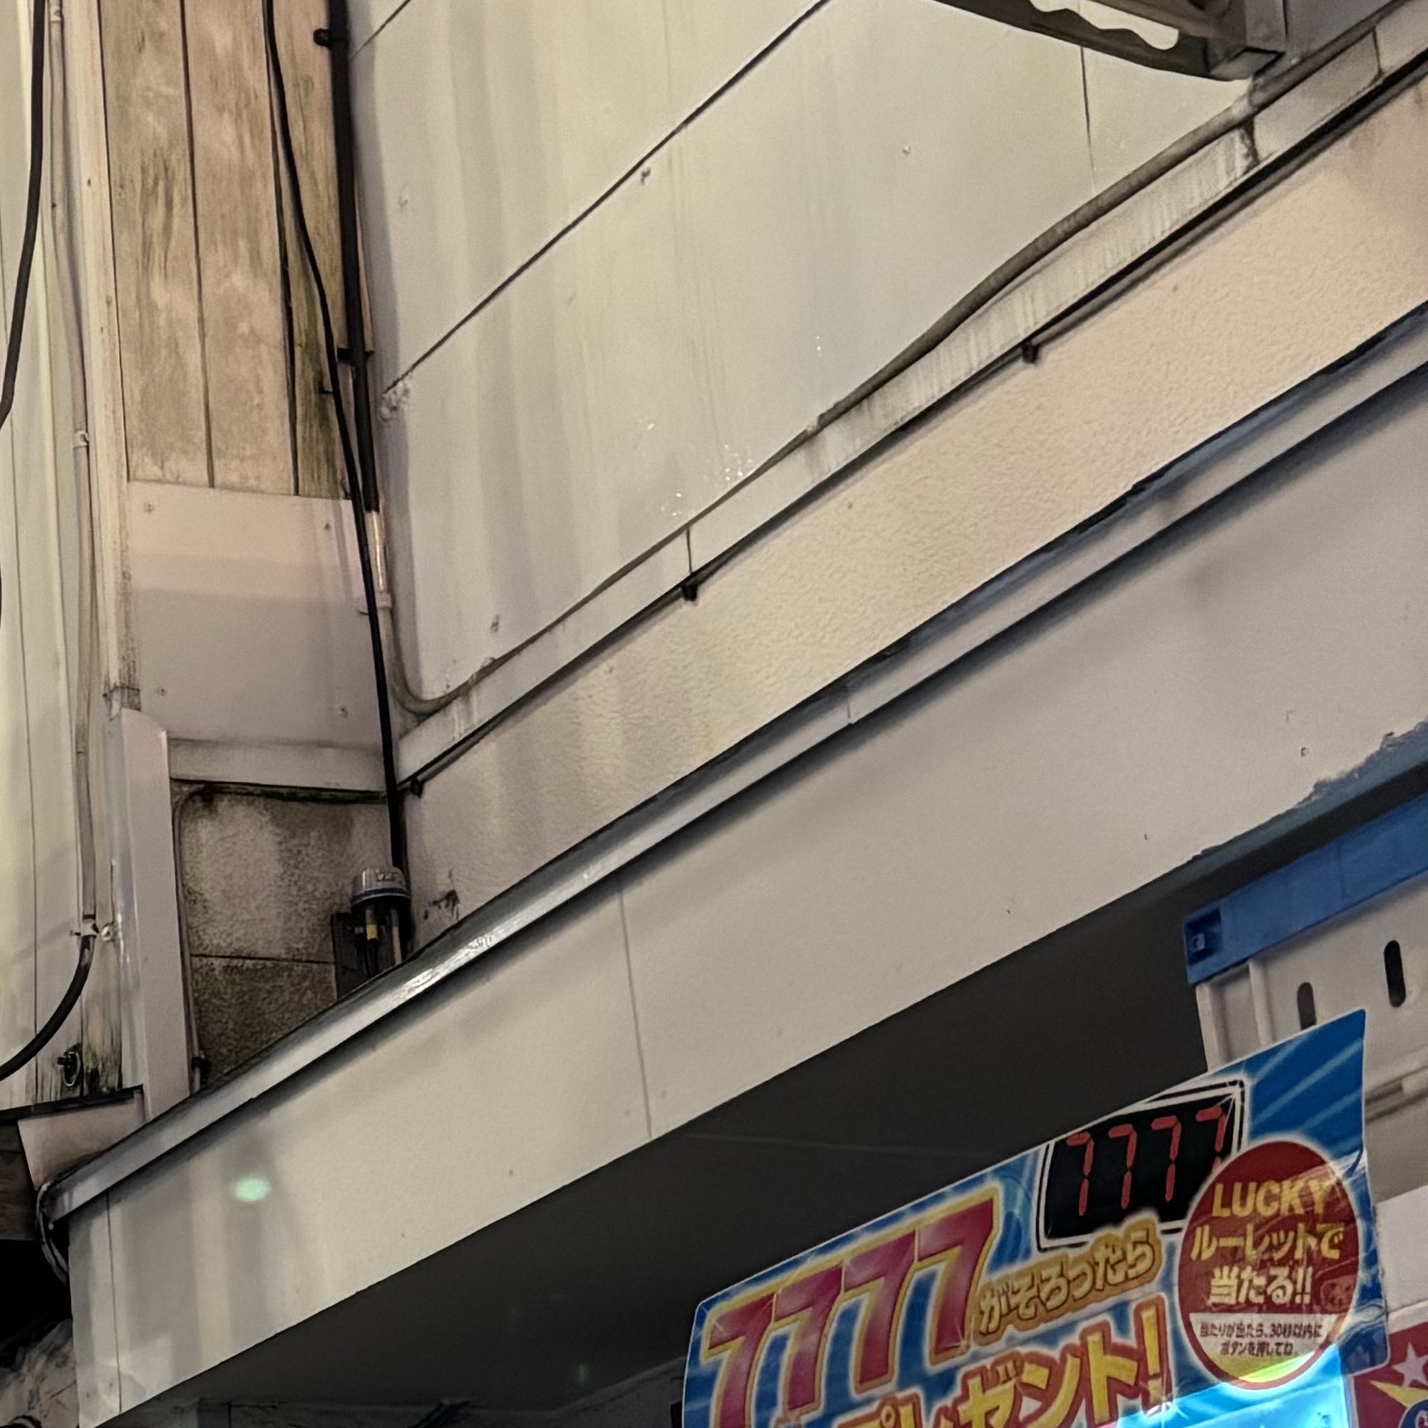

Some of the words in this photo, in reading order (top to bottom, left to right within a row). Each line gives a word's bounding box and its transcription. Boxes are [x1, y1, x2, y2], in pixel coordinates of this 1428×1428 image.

[1212, 1179, 1333, 1218] LUCKY
[1190, 1222, 1345, 1261] ルーレットで
[977, 1228, 1157, 1338] がそろったら
